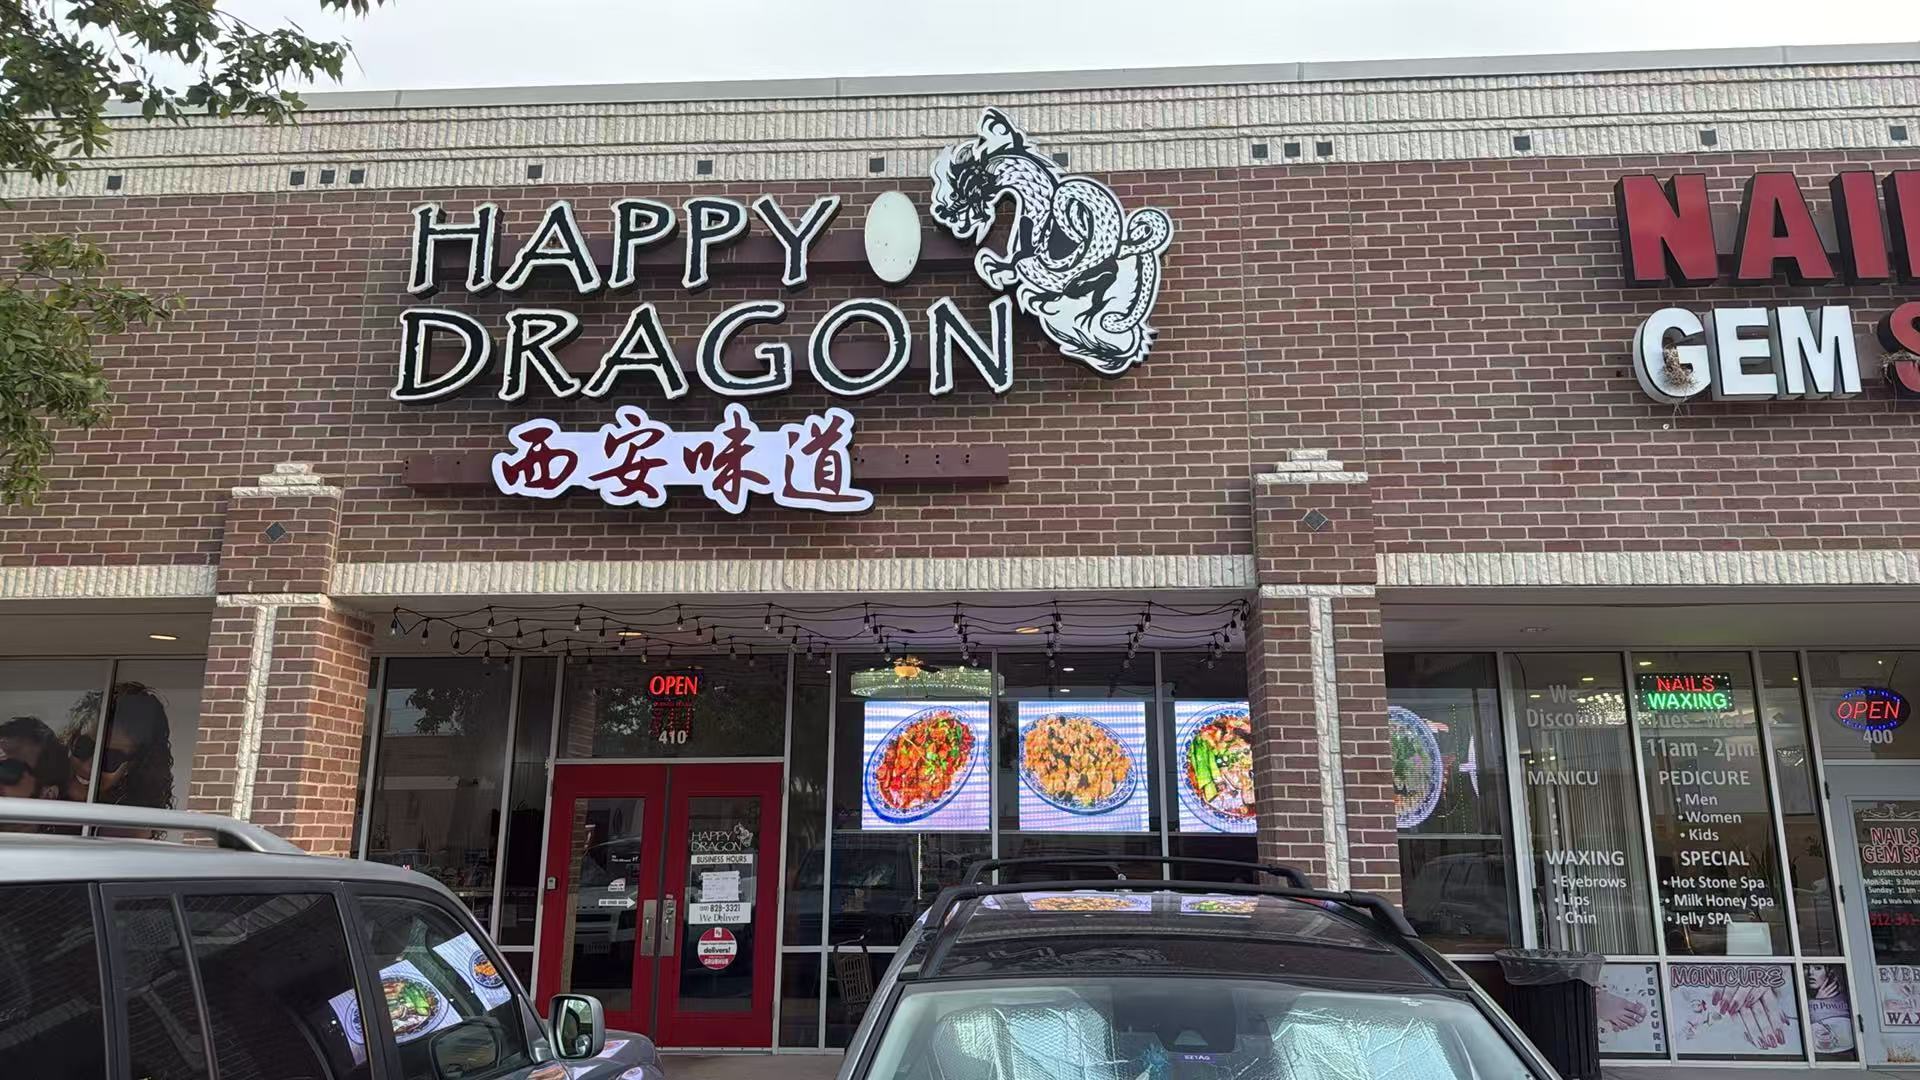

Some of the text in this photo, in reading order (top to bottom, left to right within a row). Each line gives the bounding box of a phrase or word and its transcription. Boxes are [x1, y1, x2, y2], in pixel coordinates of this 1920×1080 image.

[407, 194, 840, 294] HAPPY
[391, 295, 1014, 400] DRAGON
[1635, 305, 1861, 400] GEM
[502, 410, 867, 505] 西安味道
[649, 675, 699, 695] OPEN
[1656, 677, 1716, 692] NAILS
[1548, 684, 1578, 703] We
[1648, 693, 1728, 708] WAXING
[1837, 701, 1900, 719] OPEN
[658, 729, 689, 744] 410
[1863, 729, 1894, 744] 400
[1646, 738, 1698, 757] 11am
[1713, 738, 1755, 762] 2pm
[1527, 770, 1598, 785] MANICU
[1659, 770, 1751, 786] PEDICURE
[1684, 793, 1718, 806] Men
[1685, 810, 1742, 823] Women
[691, 830, 732, 841] HAPPY
[1688, 828, 1720, 841] Kids
[1870, 827, 1919, 846] NAILS
[691, 841, 742, 852] DRAGON
[1862, 844, 1901, 863] GEM
[697, 855, 747, 864] BUSINESS HOURS
[1545, 849, 1625, 866] WAXING
[1680, 850, 1750, 867] SPECIAL
[1561, 874, 1627, 890] Eyebrows
[1670, 875, 1765, 891] Hot Stone Spa
[1562, 893, 1590, 908] Lips
[1673, 893, 1774, 910] Milk Honey Spa
[700, 912, 741, 922] We Deliver
[1565, 911, 1597, 924] Chin
[1675, 912, 1734, 927] Jelly SPA
[1645, 966, 1662, 1052] PEDICURE
